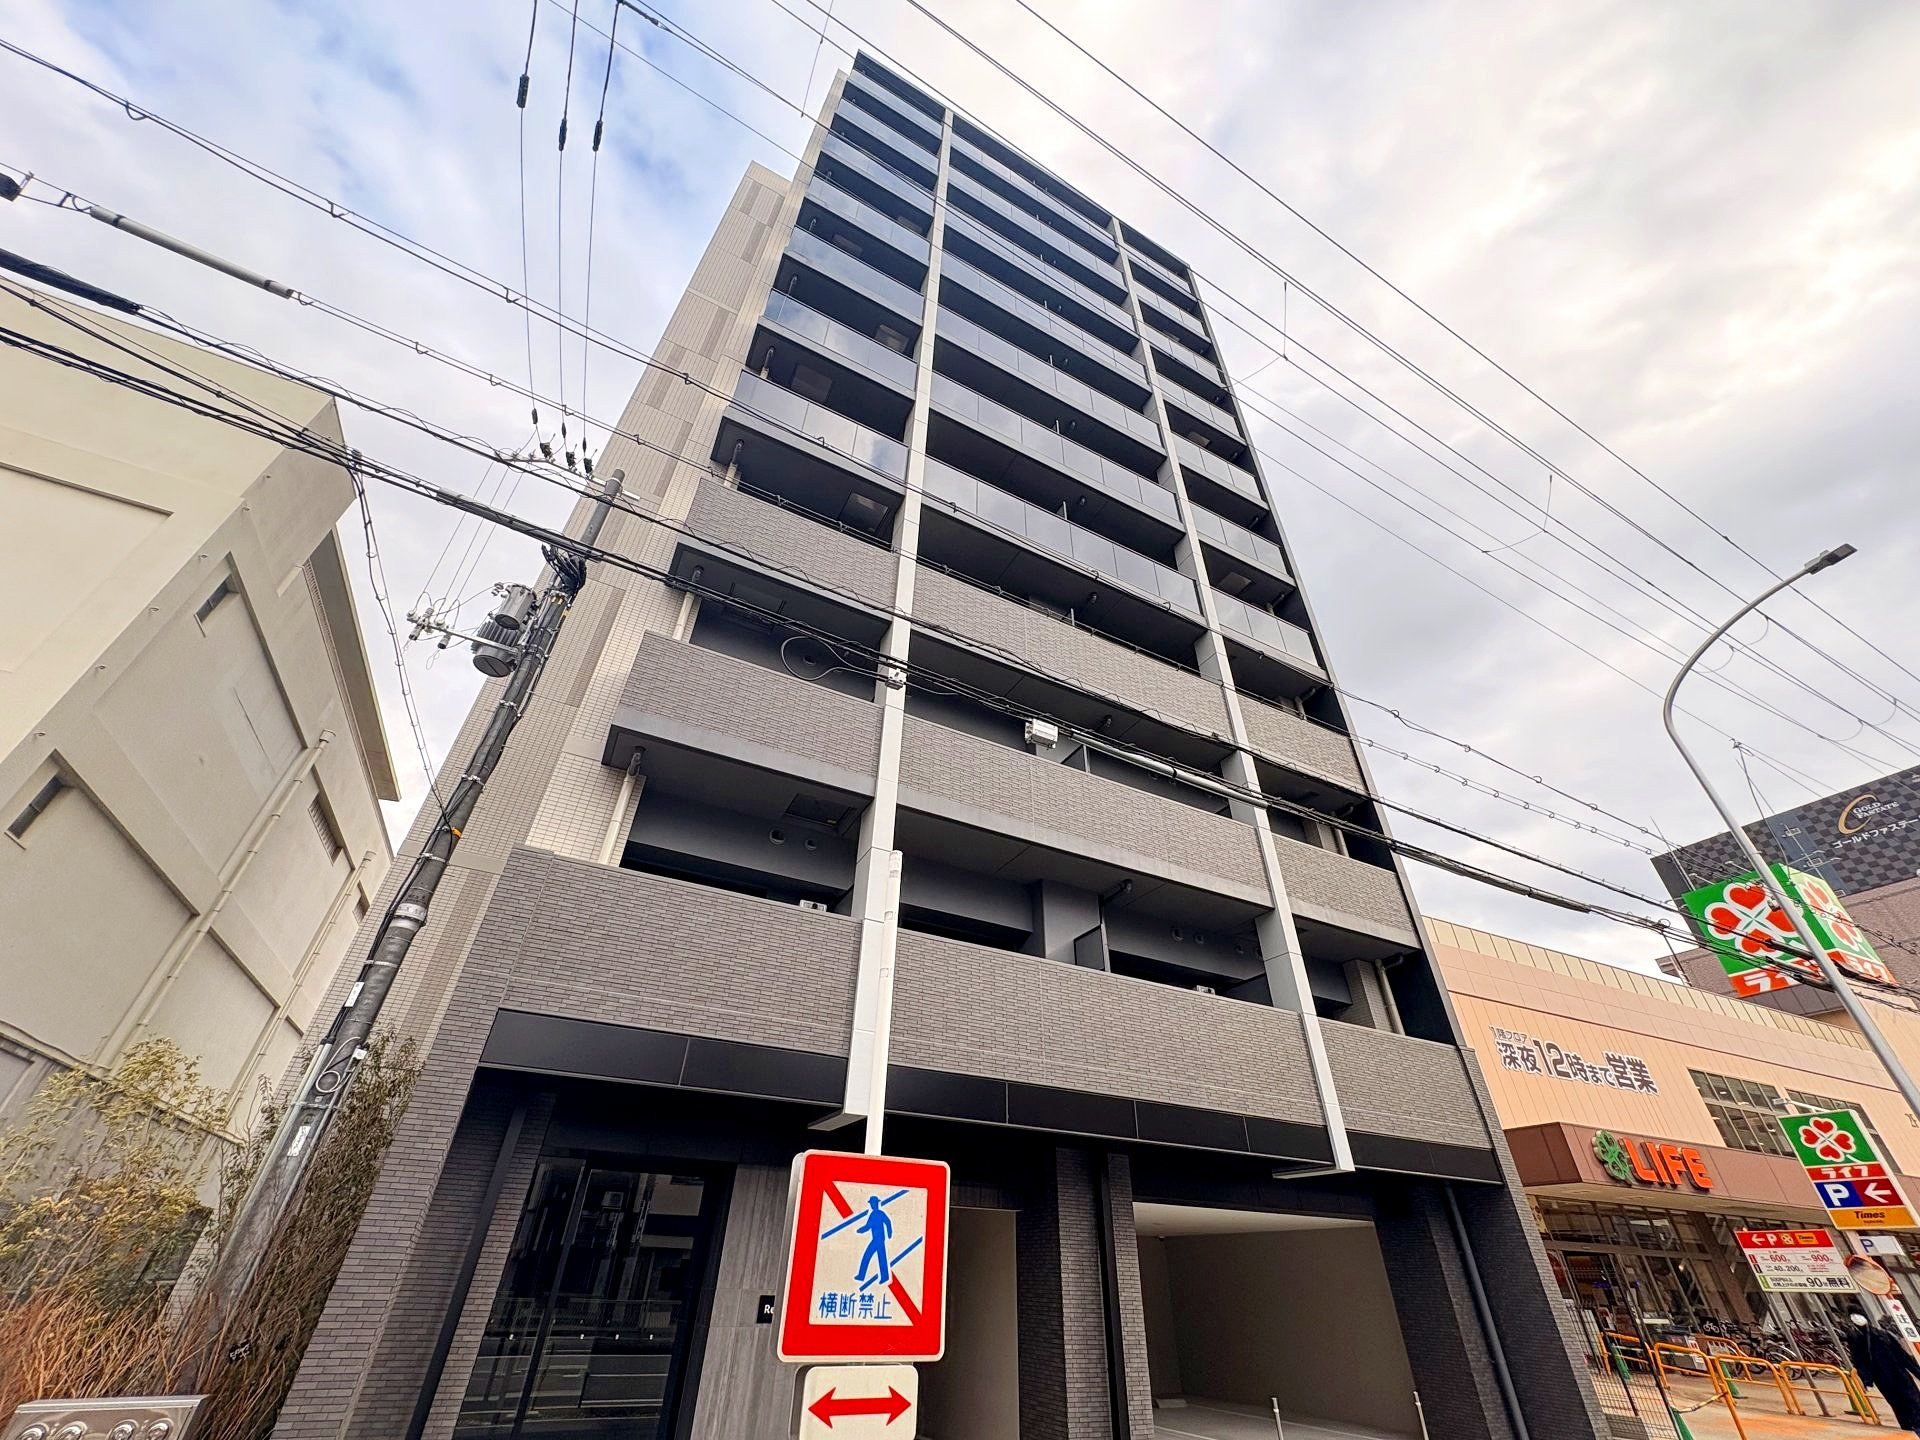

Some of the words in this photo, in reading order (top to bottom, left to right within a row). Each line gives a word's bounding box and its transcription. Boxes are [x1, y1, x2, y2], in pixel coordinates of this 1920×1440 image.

[1853, 802, 1881, 814] GOLD
[1832, 815, 1920, 848] ゴールドファステー
[1496, 1038, 1659, 1094] 深夜12時まで営業
[1621, 1137, 1713, 1189] LIFE
[1821, 1165, 1869, 1179] ライフ
[1823, 1183, 1850, 1207] P
[1854, 1210, 1886, 1219] Times
[1766, 1233, 1777, 1245] P
[1860, 1239, 1874, 1253] P
[819, 1292, 892, 1319] 横断禁止
